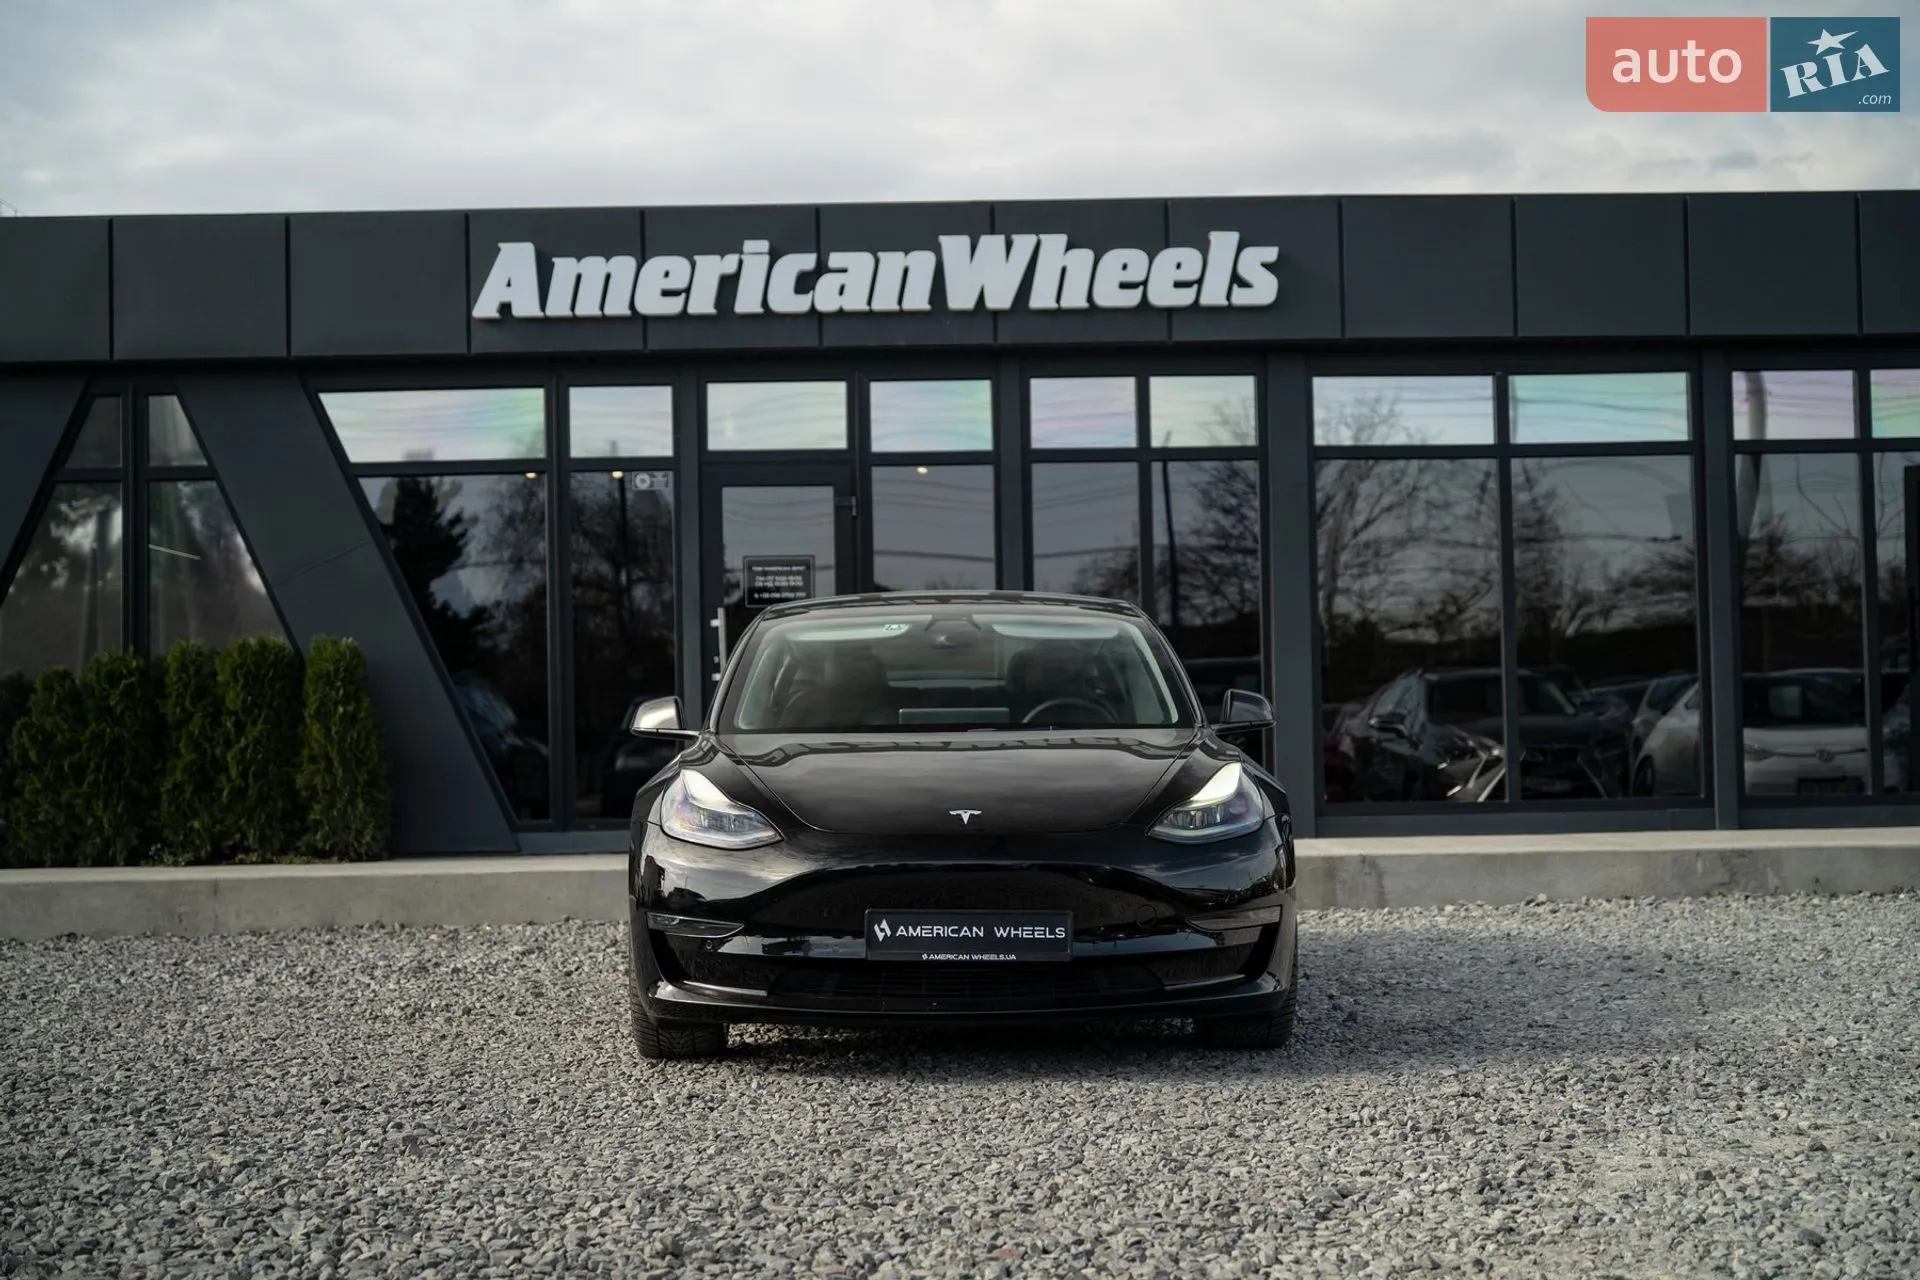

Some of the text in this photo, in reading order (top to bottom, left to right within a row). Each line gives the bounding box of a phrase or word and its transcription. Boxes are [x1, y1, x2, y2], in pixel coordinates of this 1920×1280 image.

[896, 926, 1066, 939] AMERICAN WHEELS
[929, 953, 1017, 961] AMERICAN WHEELS.UA
